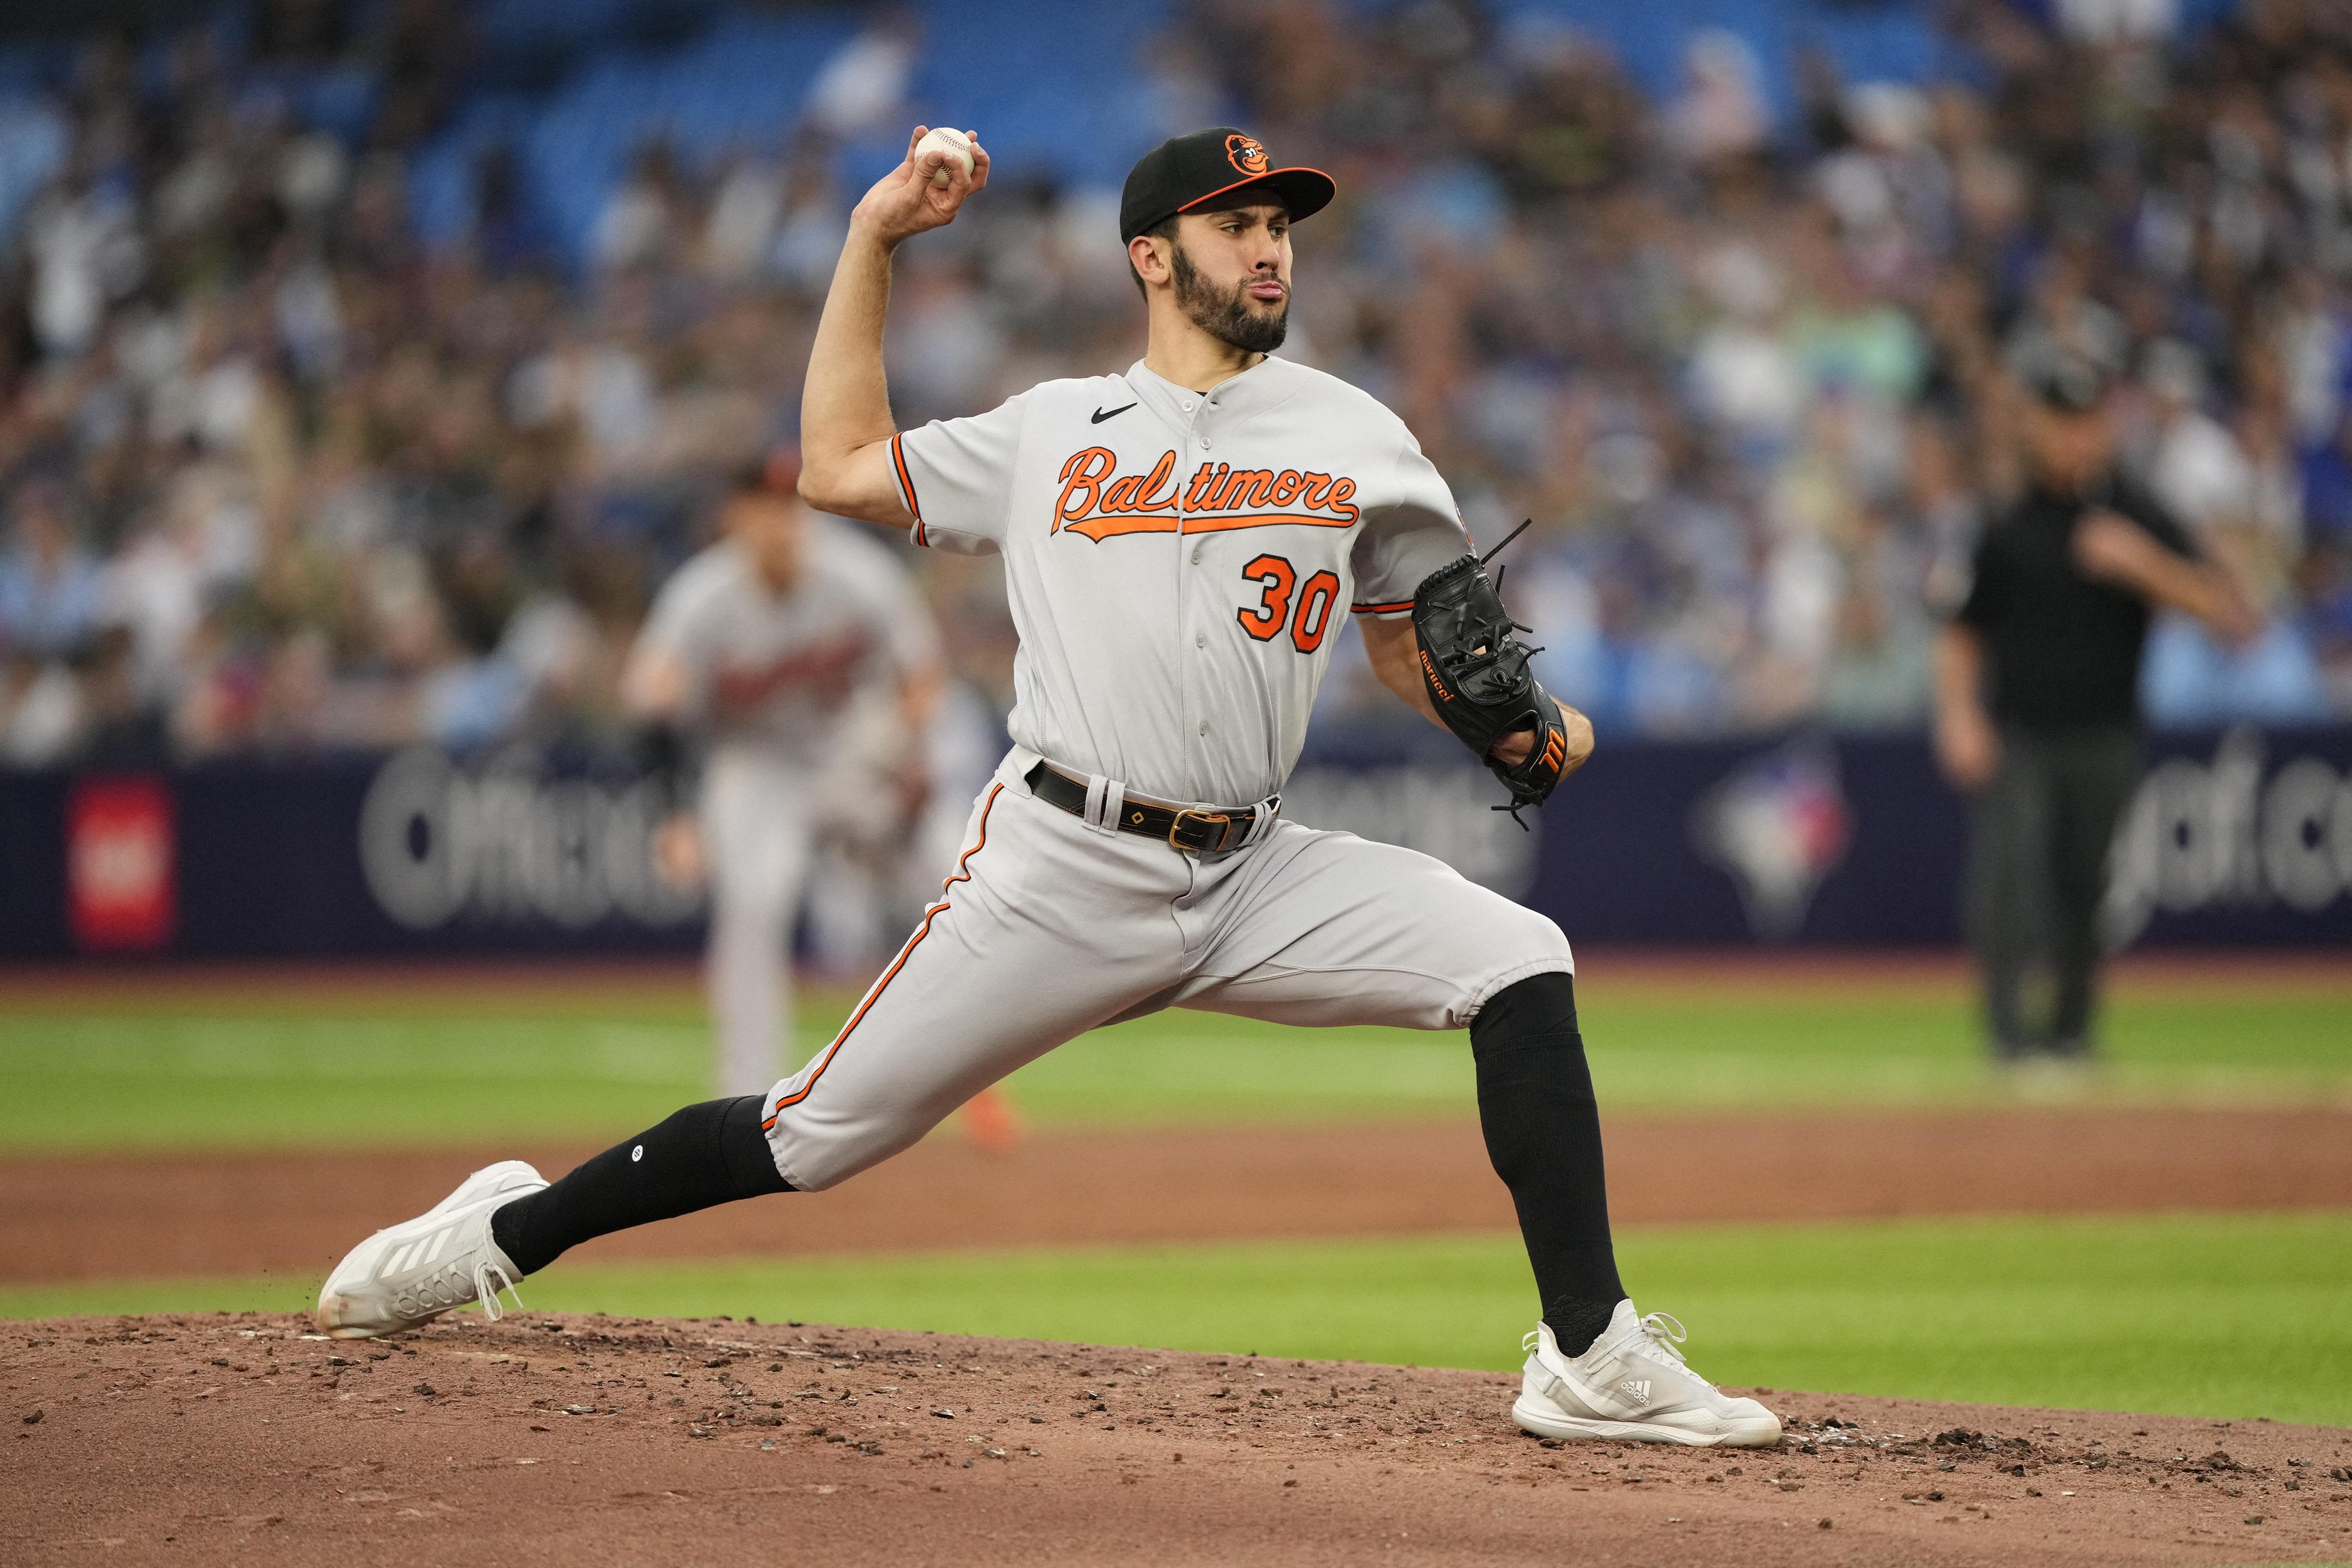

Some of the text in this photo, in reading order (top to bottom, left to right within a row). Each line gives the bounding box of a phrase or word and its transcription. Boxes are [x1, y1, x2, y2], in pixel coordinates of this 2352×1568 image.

[1050, 446, 1360, 540] Baltimore
[1236, 553, 1340, 654] 30
[1420, 650, 1455, 702] marucci
[1621, 1382, 1651, 1406] adidas
